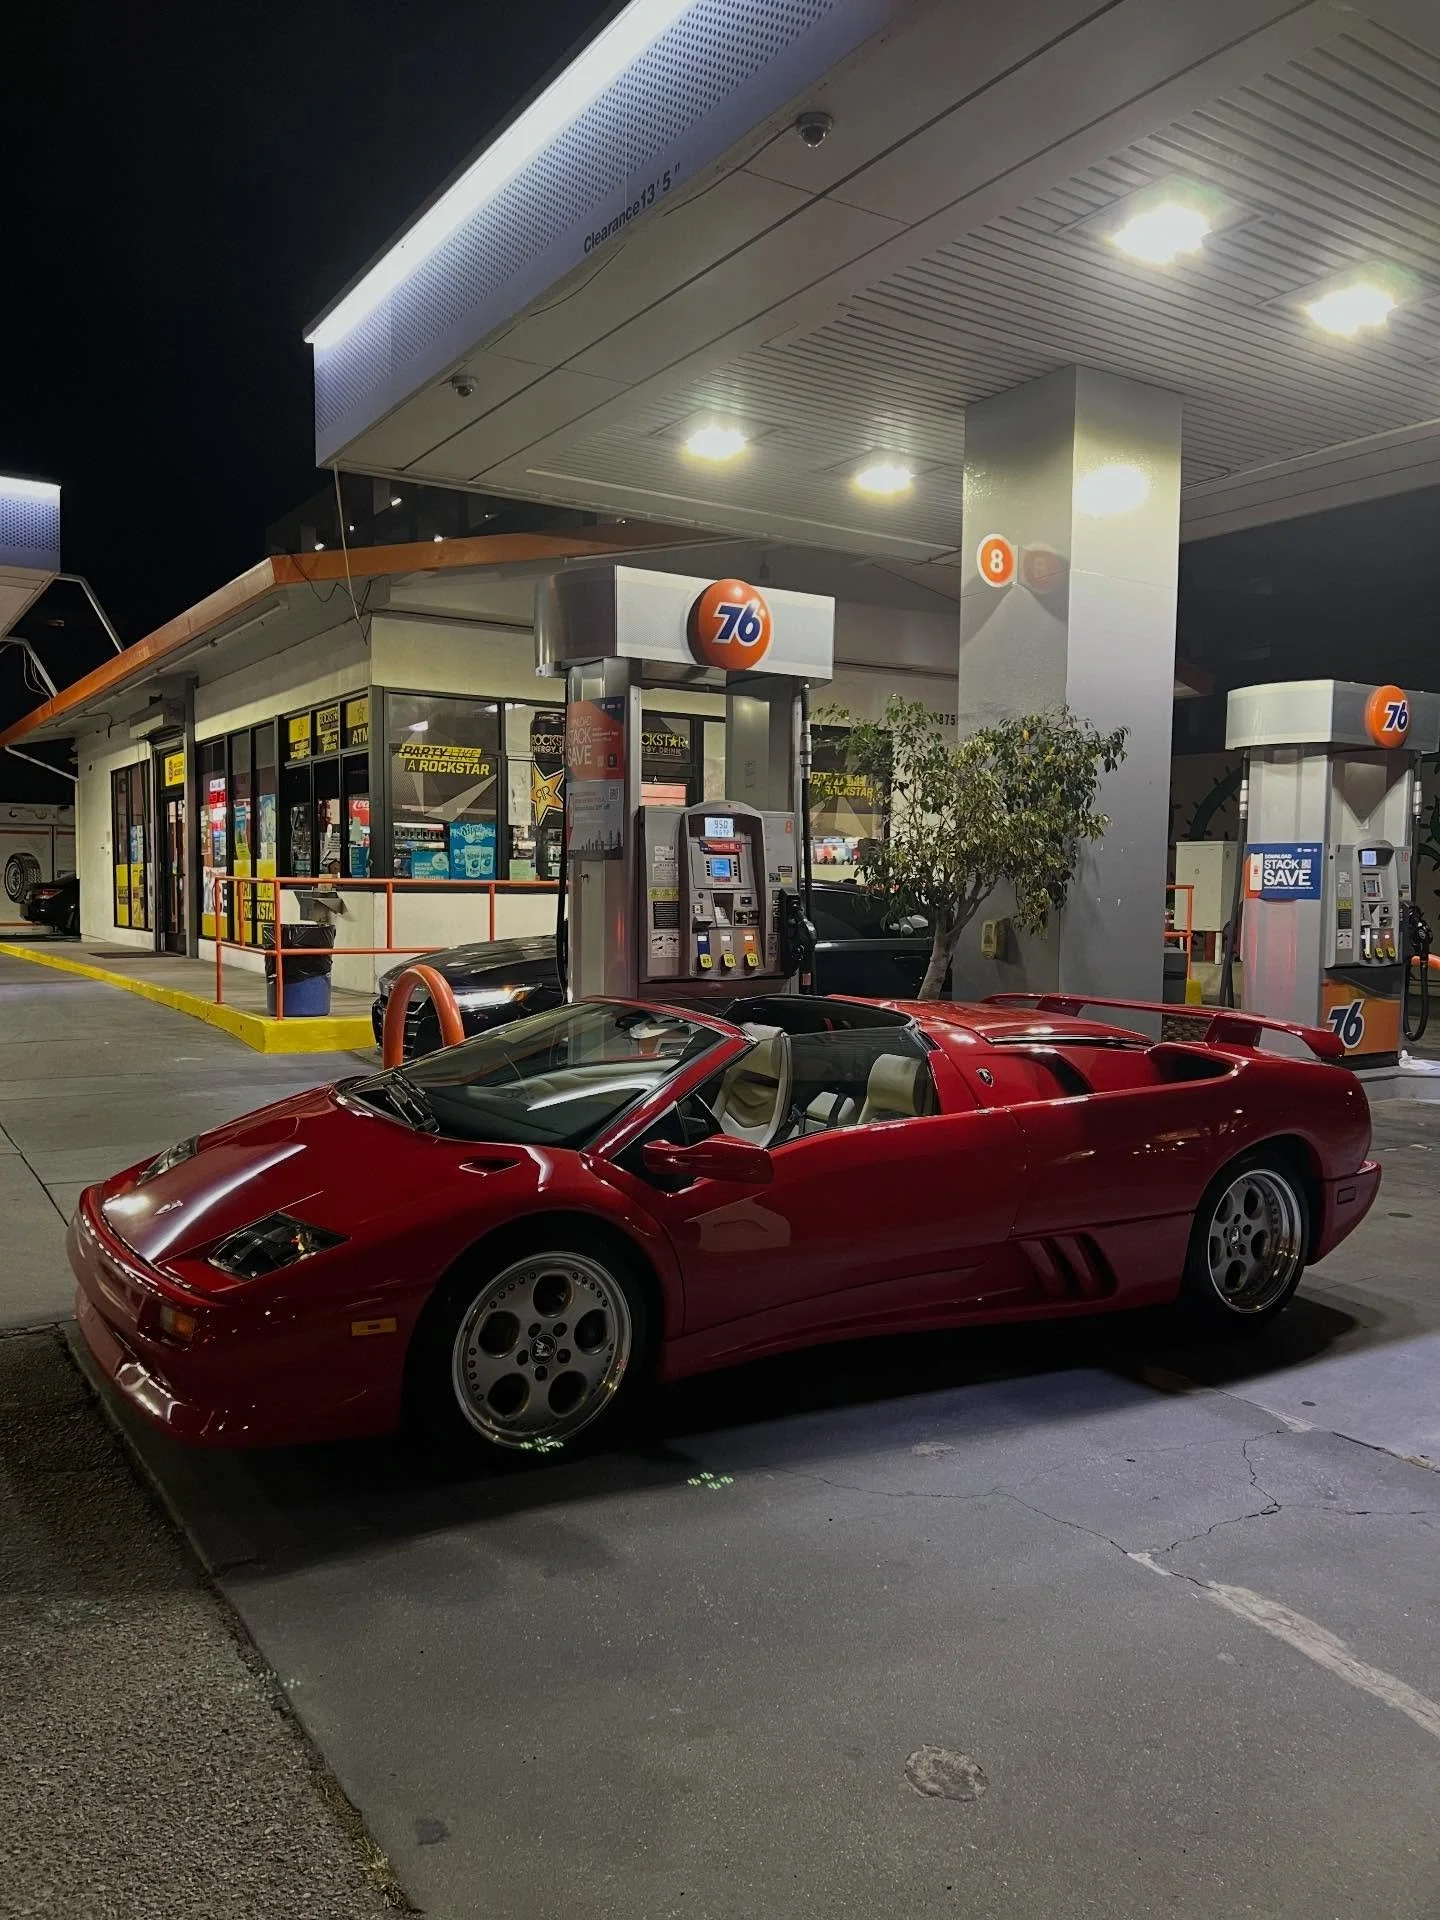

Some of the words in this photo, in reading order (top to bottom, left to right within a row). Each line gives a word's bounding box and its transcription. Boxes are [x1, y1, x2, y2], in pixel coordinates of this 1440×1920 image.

[583, 201, 640, 254] Clearance
[990, 548, 1004, 573] 8
[712, 600, 763, 646] 76
[1382, 700, 1408, 732] 76
[402, 745, 448, 758] PARTY
[407, 760, 416, 771] A
[419, 760, 490, 775] ROCKSTAR
[1263, 859, 1300, 869] STACK
[1263, 870, 1312, 886] SAVE
[1326, 999, 1364, 1050] 76
